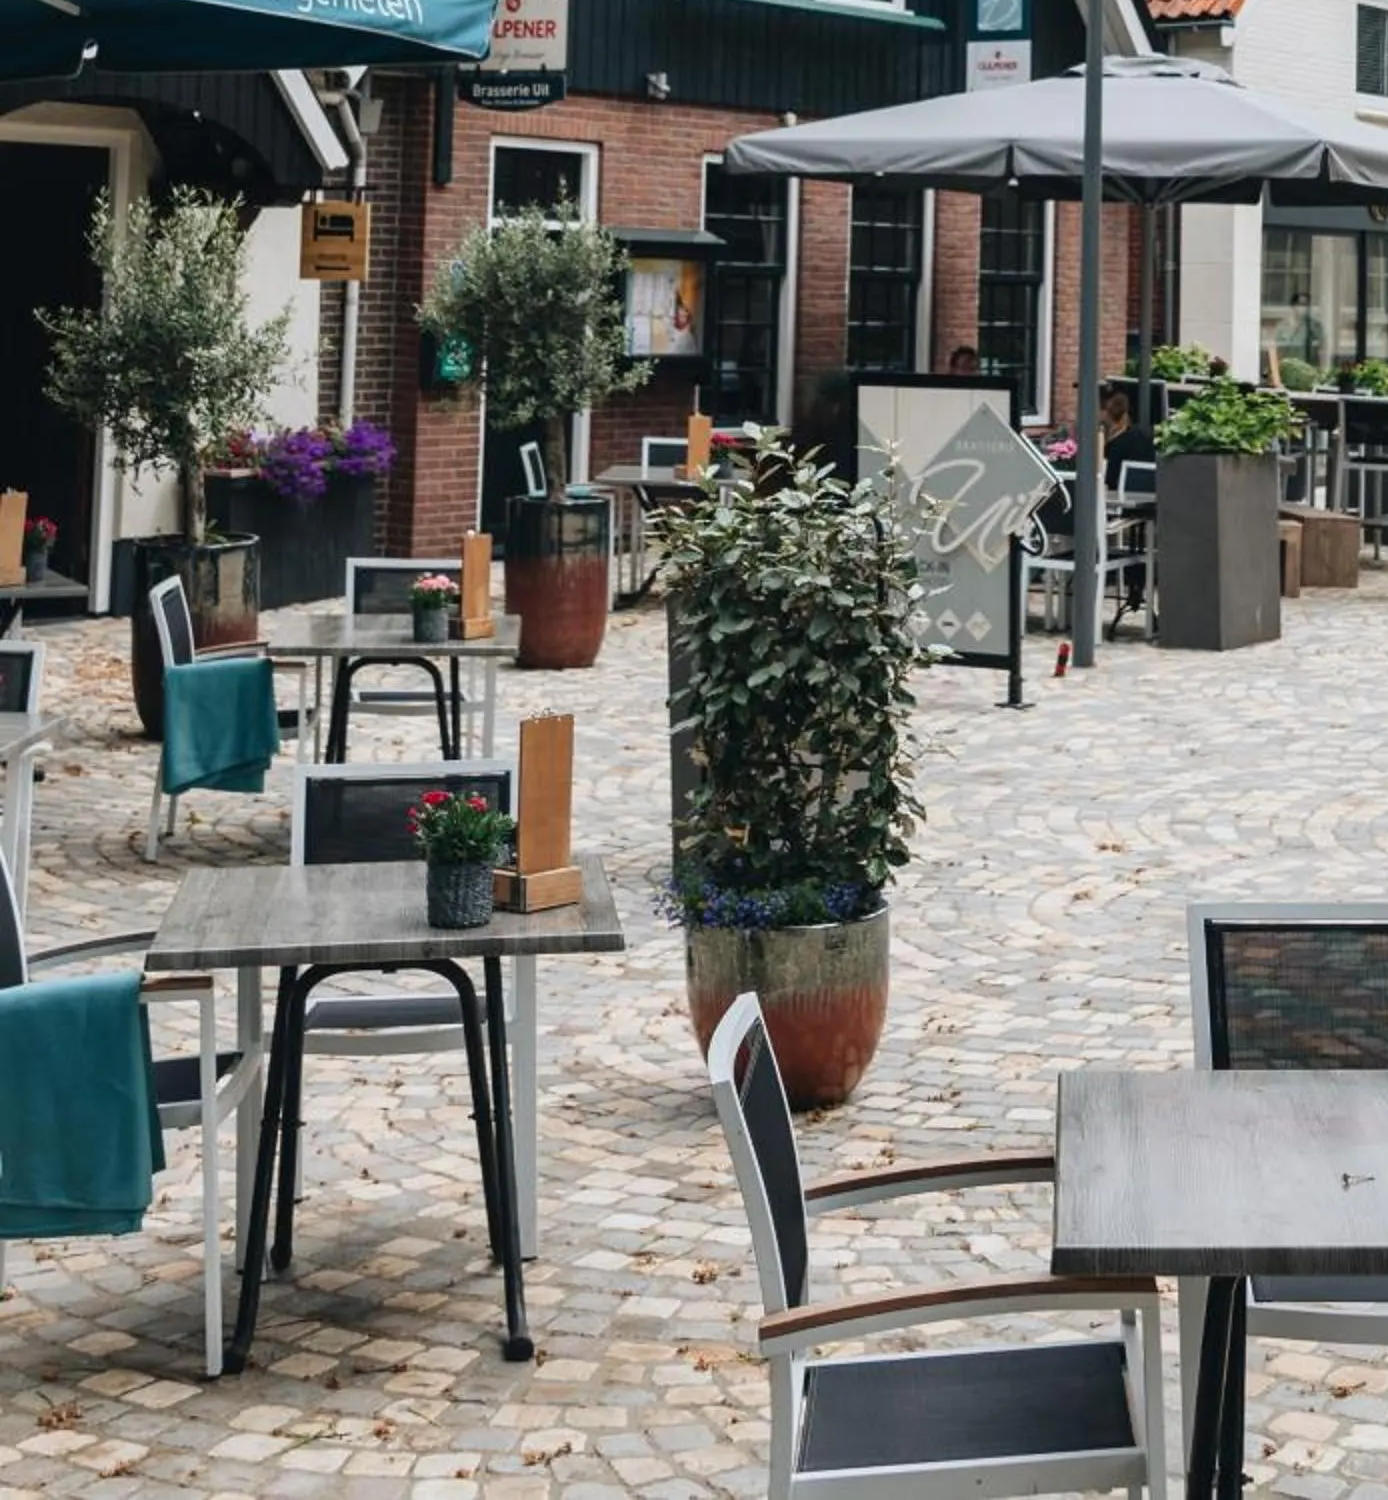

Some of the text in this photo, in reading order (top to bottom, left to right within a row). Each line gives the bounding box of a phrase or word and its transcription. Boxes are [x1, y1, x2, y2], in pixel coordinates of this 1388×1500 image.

[493, 19, 557, 39] LPENER
[472, 83, 549, 97] Brasserie Uit
